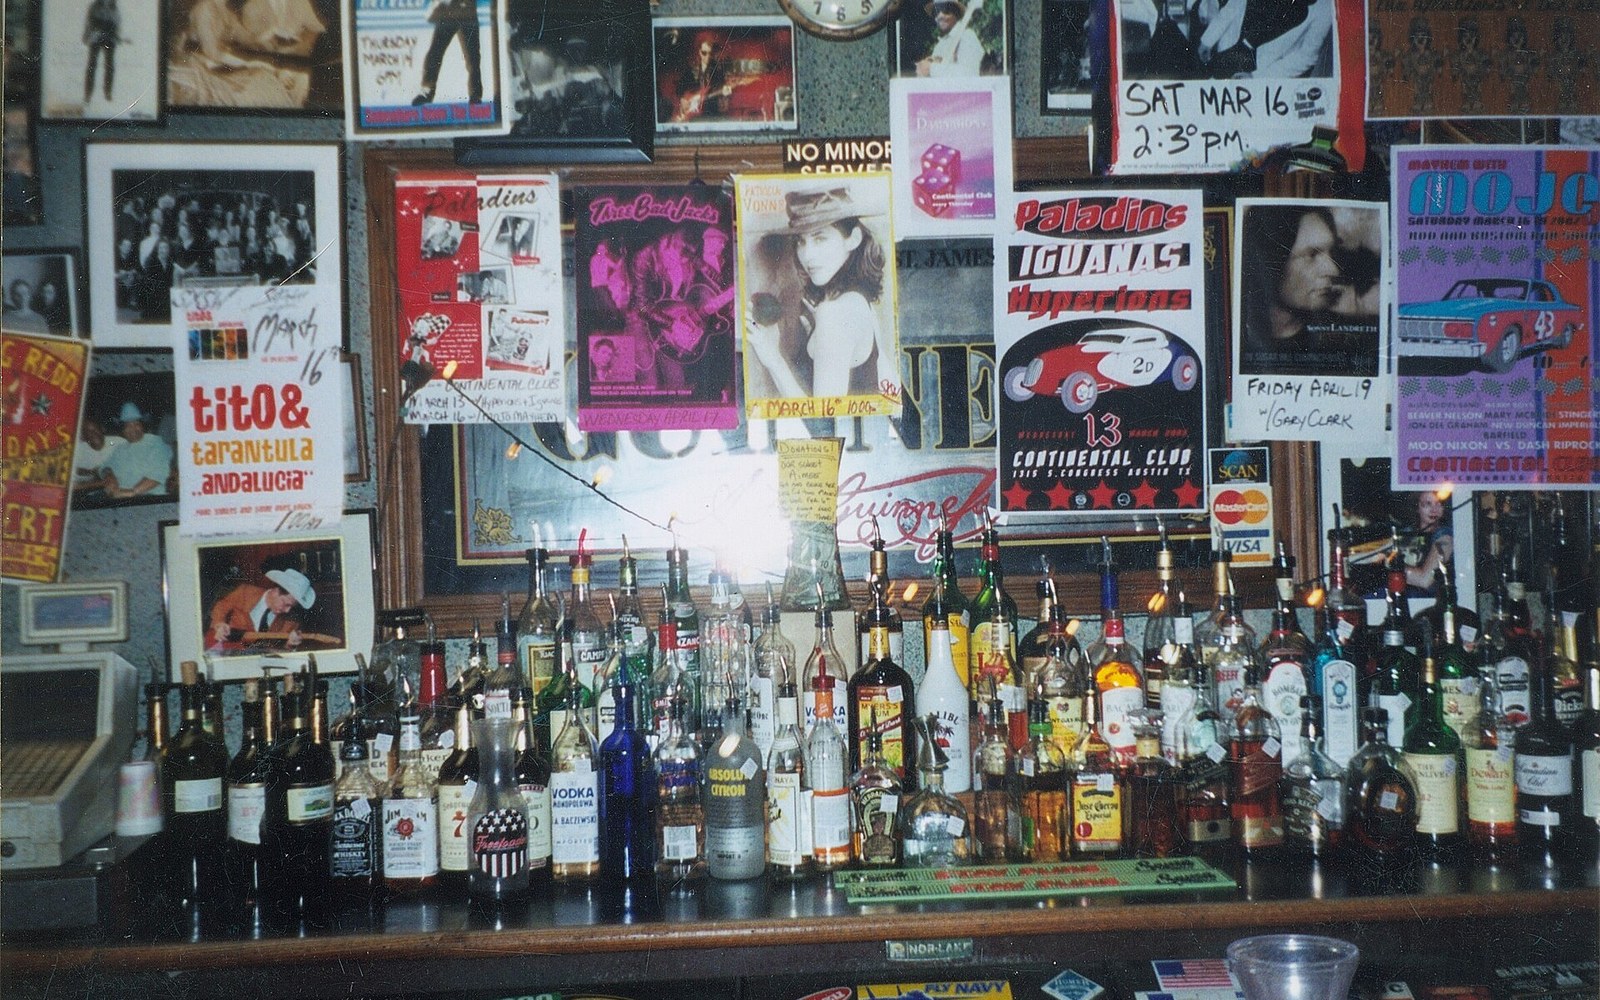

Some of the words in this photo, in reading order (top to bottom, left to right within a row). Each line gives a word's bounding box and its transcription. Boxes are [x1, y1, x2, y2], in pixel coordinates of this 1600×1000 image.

[813, 1, 822, 15] 7
[836, 7, 846, 22] 6
[1125, 82, 1185, 117] SAT
[1200, 85, 1252, 118] MAR
[1265, 85, 1289, 116] 16
[1133, 124, 1198, 160] 2:30
[787, 143, 819, 162] NO
[1014, 196, 1189, 234] Paladins
[1018, 240, 1184, 277] IGUANAS
[1007, 282, 1192, 321] Hyperions
[1533, 310, 1556, 340] 43
[527, 378, 560, 391] CLUB
[1248, 378, 1302, 402] FRIDAY
[1310, 378, 1352, 397] APRIL
[1355, 378, 1372, 400] 19
[767, 400, 815, 417] MARCH
[1407, 411, 1442, 420] BEAVER
[1444, 411, 1483, 420] NELSON
[664, 410, 701, 425] APRIL
[1307, 409, 1353, 430] CLARK
[1082, 411, 1122, 448] 13
[1128, 428, 1159, 438] MARCH
[1483, 431, 1527, 440] BARFIELD
[1407, 441, 1443, 451] MOJO
[1446, 440, 1488, 451] NIXON
[1517, 441, 1550, 450] DASH
[1013, 449, 1132, 468] CONTINENTAL
[1145, 448, 1192, 466] CLUB
[1407, 456, 1547, 473] CONTINENTAL
[1012, 469, 1038, 479] 1315
[1127, 468, 1170, 477] AUSTIN
[1178, 467, 1191, 477] TX
[1218, 464, 1259, 479] SCAN
[1226, 539, 1261, 553] VISA
[552, 787, 595, 799] VODKA
[711, 784, 746, 796] CITRON
[924, 982, 952, 993] FLY
[955, 981, 1007, 993] NAVY
